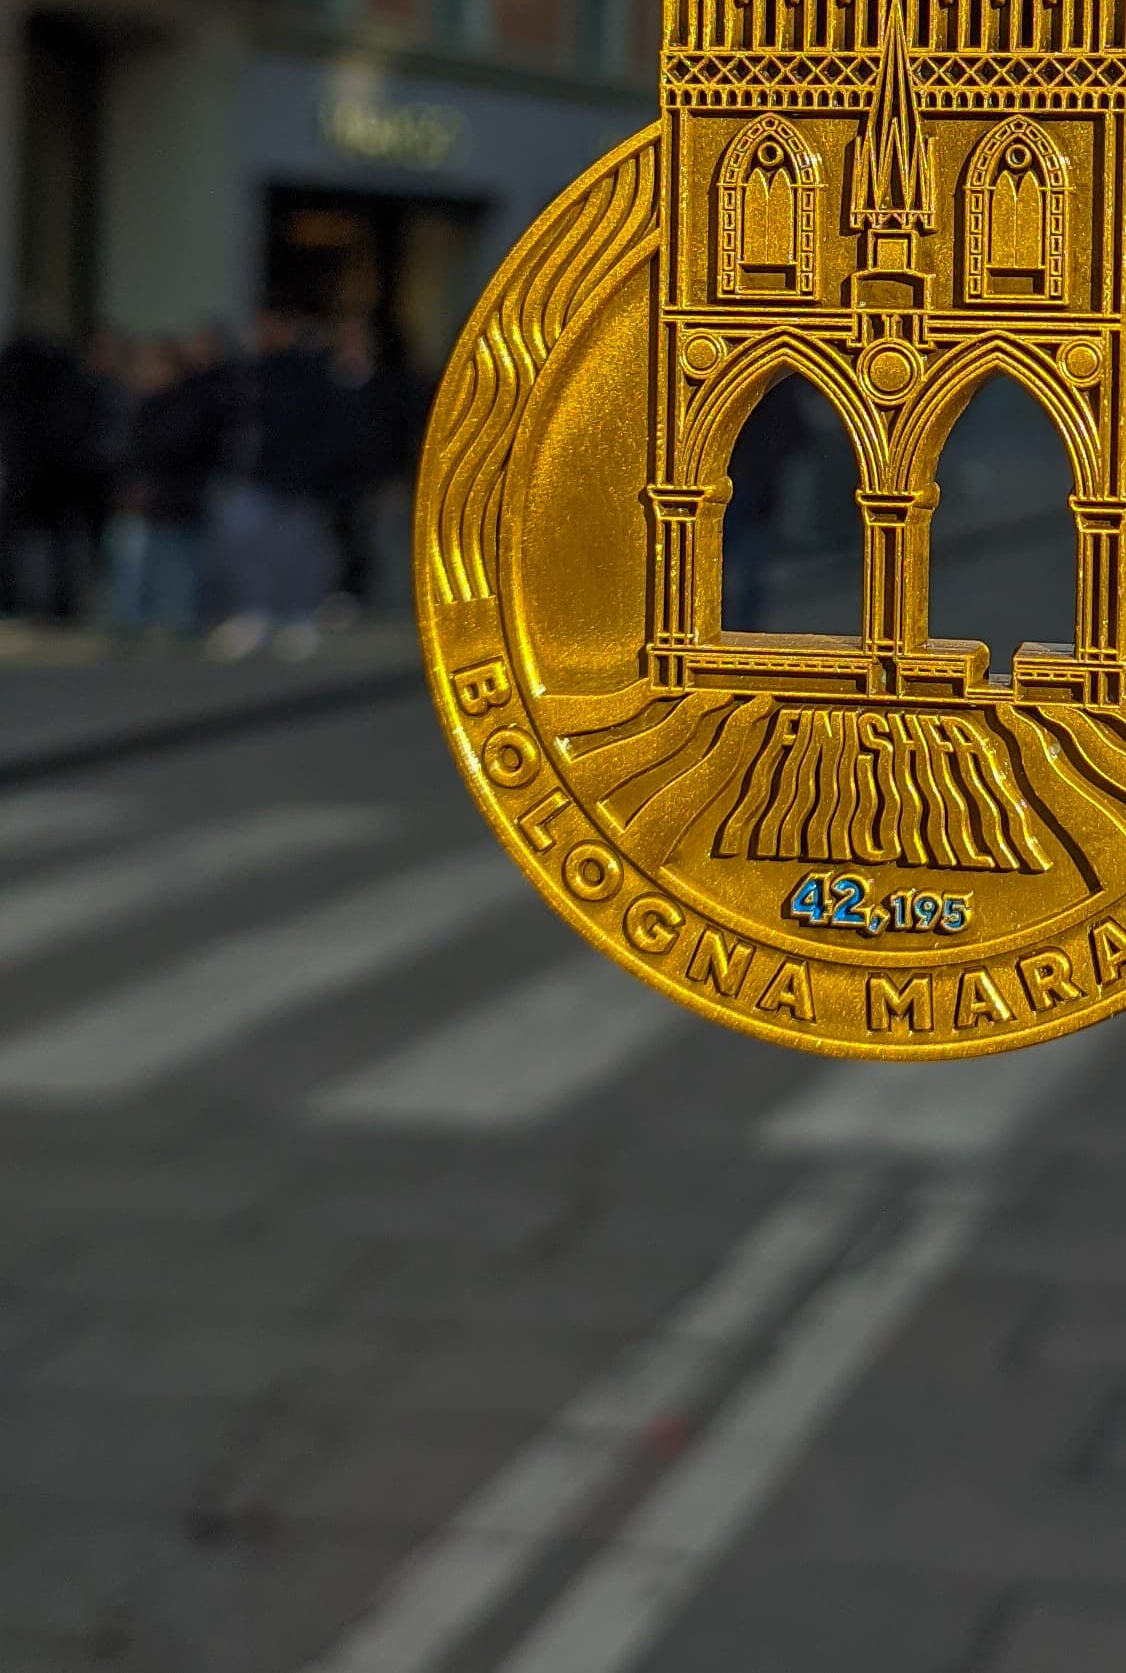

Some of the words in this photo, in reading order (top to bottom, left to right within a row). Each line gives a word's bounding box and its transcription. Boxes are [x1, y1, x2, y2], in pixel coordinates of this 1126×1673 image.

[449, 656, 818, 1024] BOLOGNA
[711, 709, 1053, 872] FINISHER
[784, 869, 974, 936] 42,195
